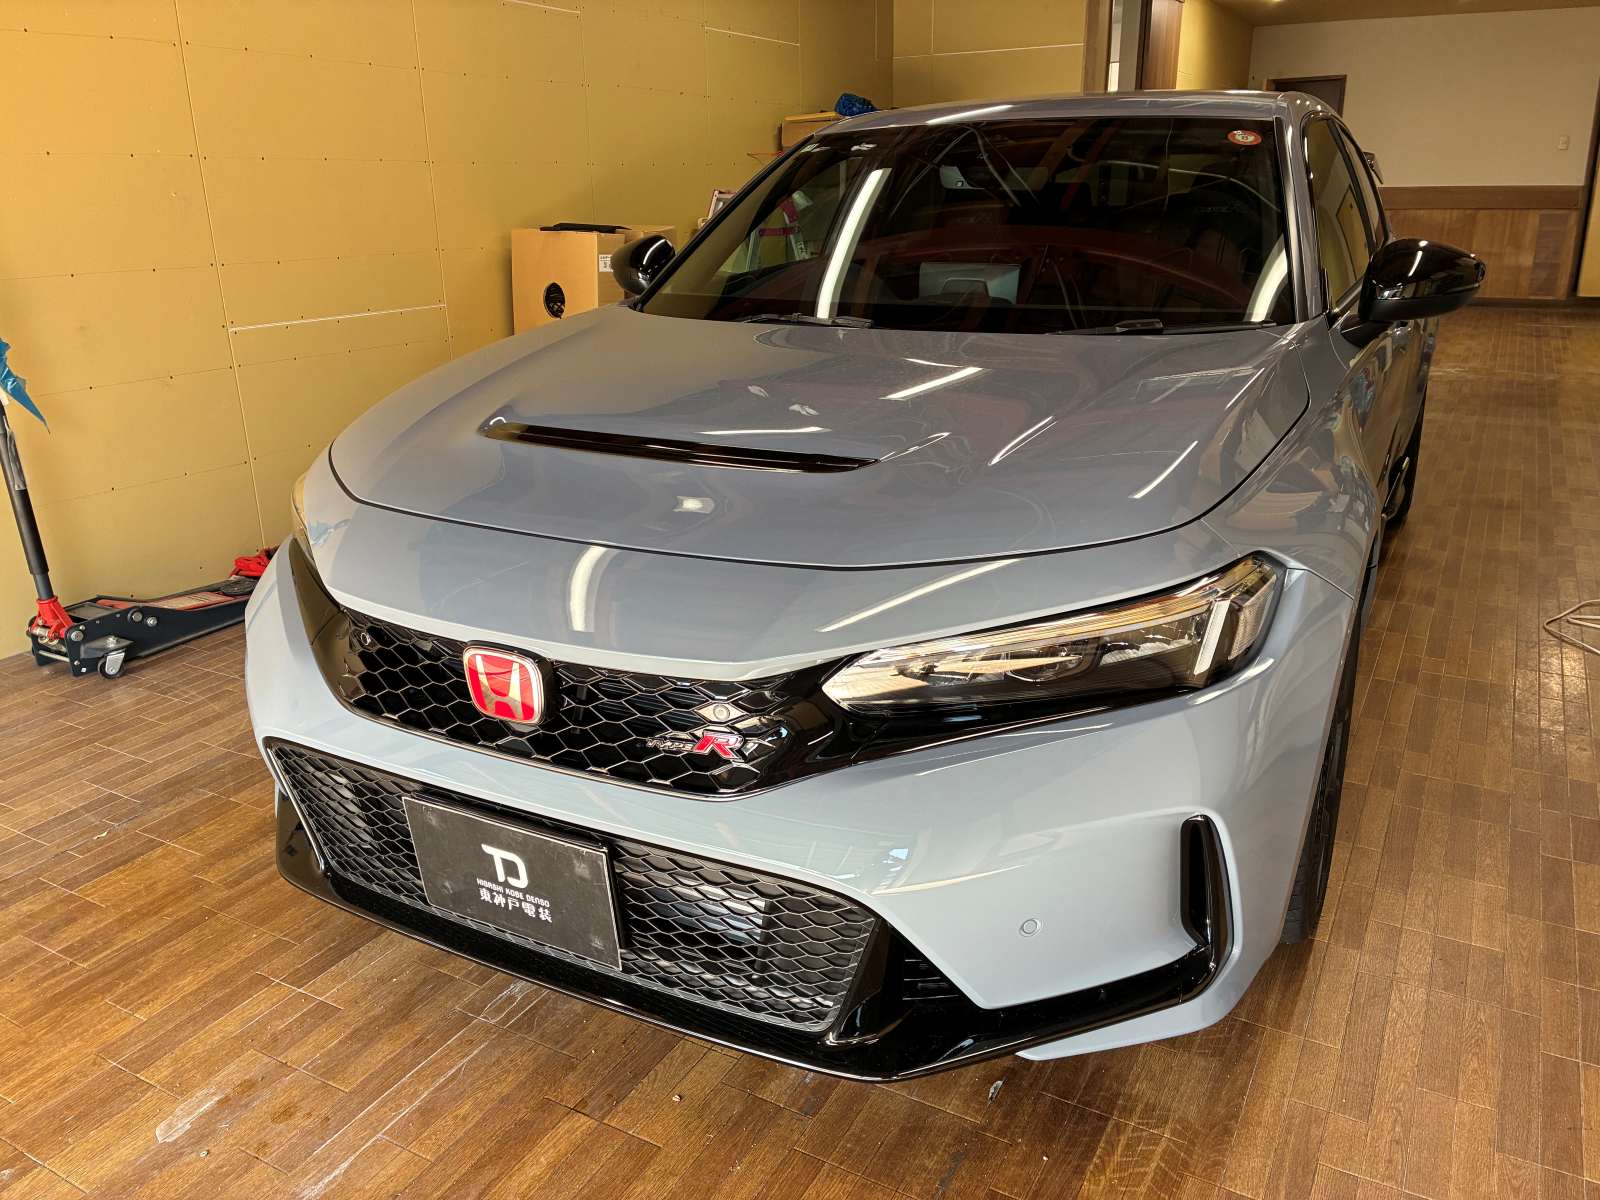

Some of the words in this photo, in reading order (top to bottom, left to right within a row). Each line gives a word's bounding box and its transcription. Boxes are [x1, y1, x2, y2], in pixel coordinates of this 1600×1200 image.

[645, 737, 692, 751] TYPE
[692, 729, 745, 762] R
[479, 887, 553, 923] 東神戸電装
[505, 887, 525, 900] KOBE
[525, 894, 550, 908] DENSO
